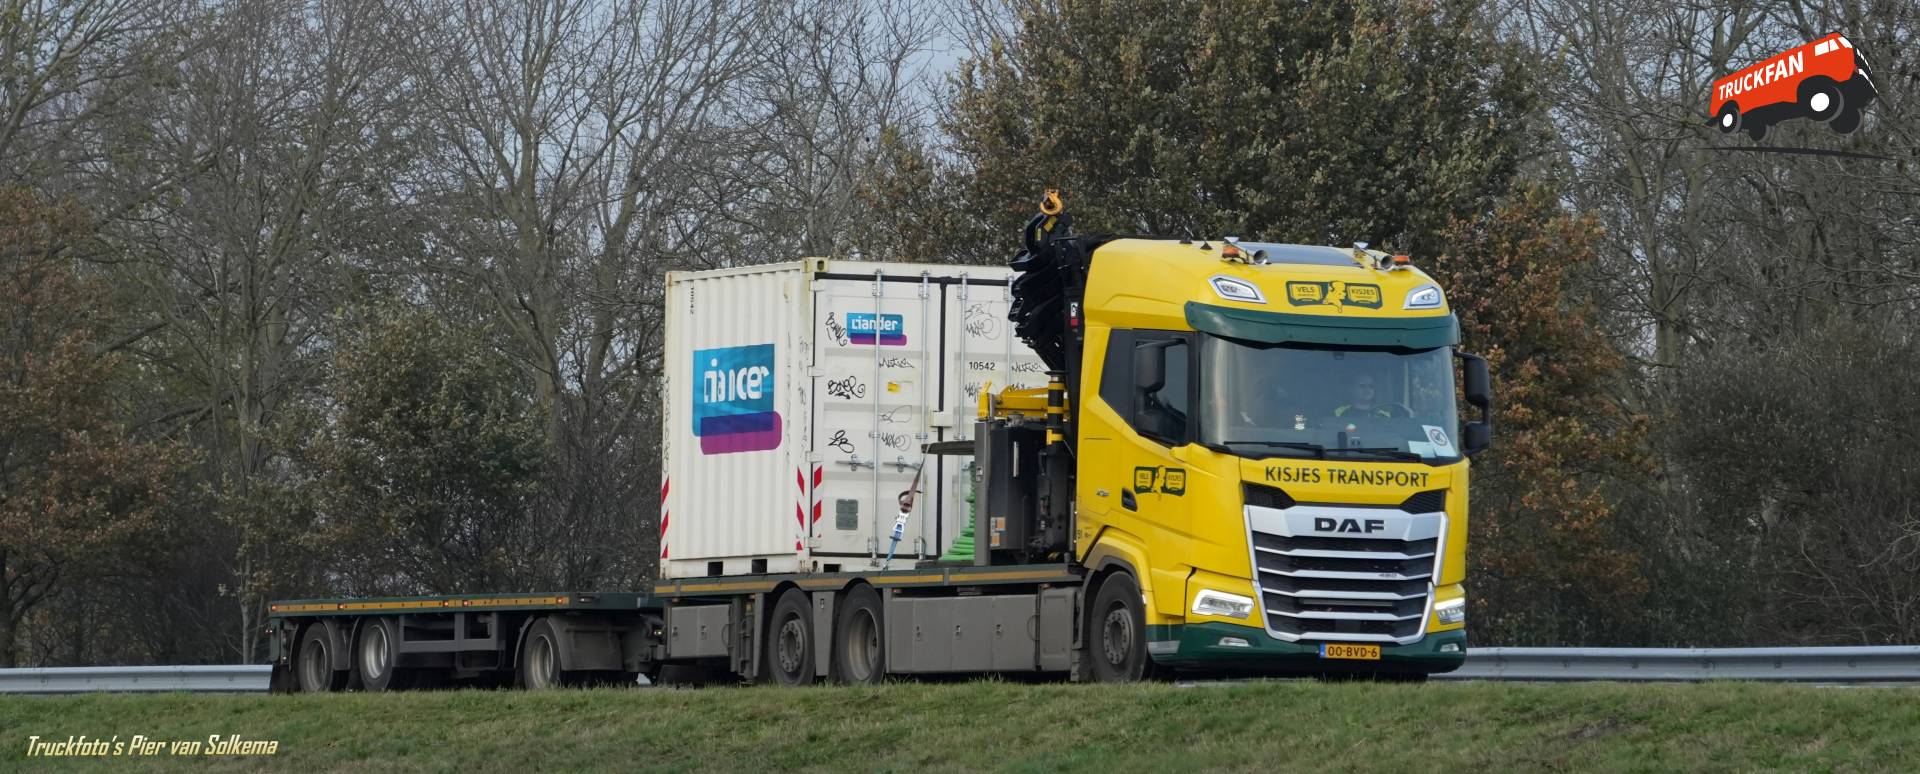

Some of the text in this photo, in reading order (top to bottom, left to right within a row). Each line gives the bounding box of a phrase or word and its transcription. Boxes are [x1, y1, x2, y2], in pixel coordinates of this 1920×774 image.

[969, 361, 996, 371] 10542
[1265, 466, 1429, 488] KISJES TRANSPORT
[1314, 517, 1385, 534] DAF
[1328, 646, 1378, 658] 00-BVD-6
